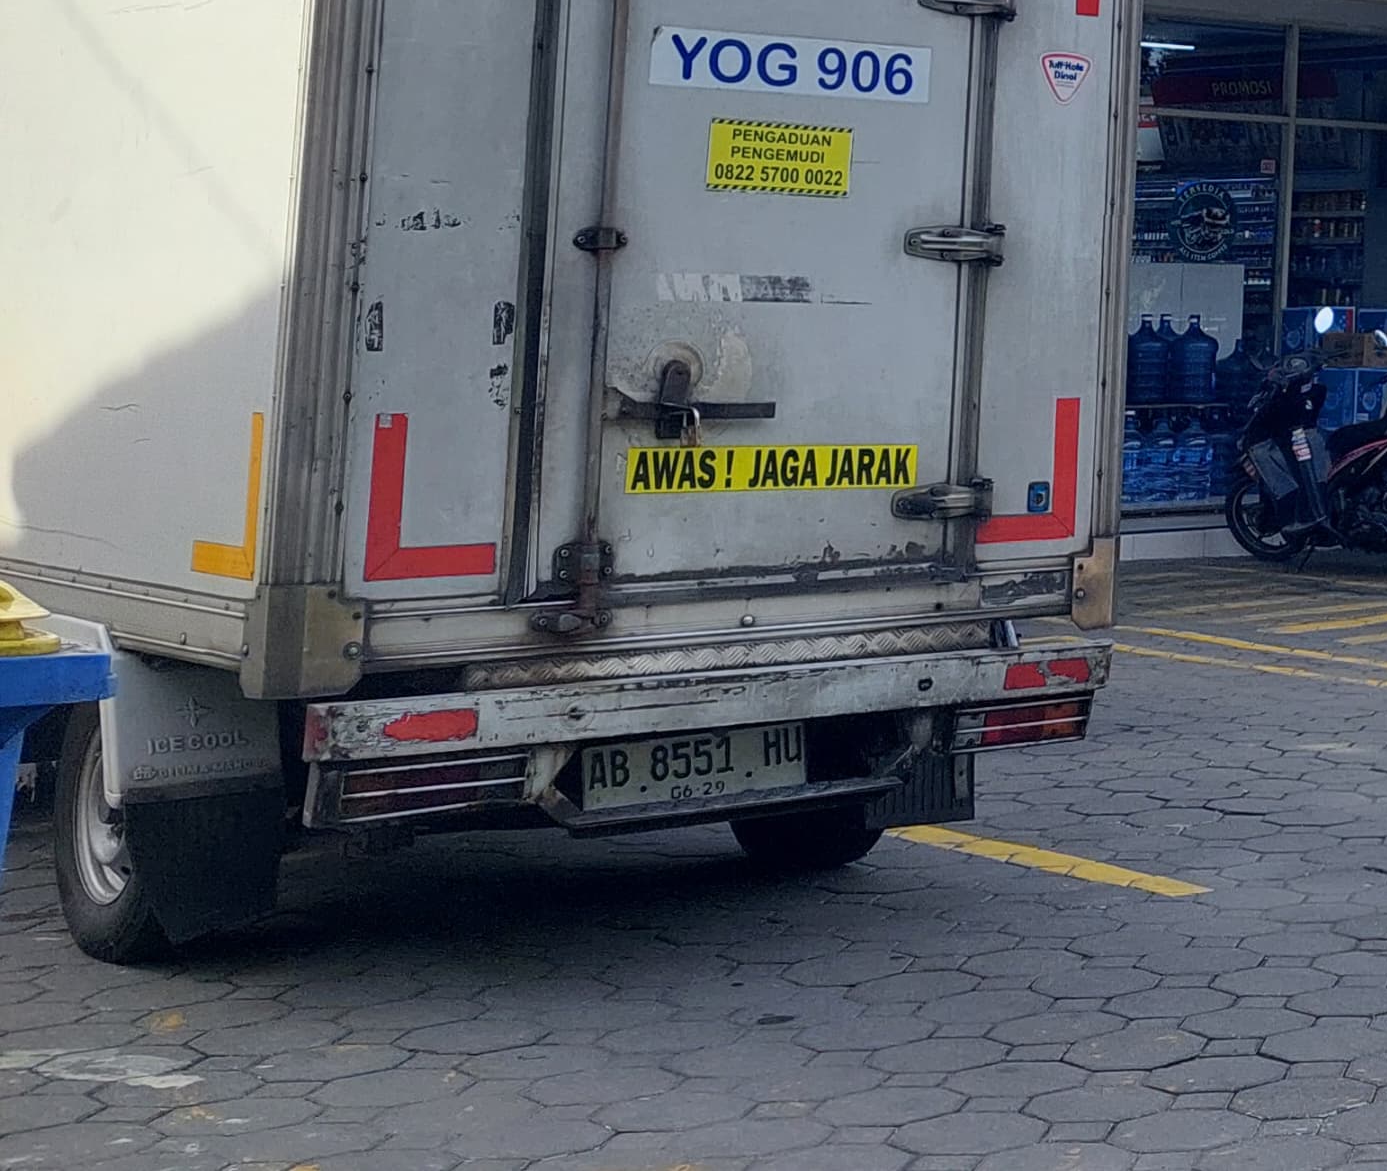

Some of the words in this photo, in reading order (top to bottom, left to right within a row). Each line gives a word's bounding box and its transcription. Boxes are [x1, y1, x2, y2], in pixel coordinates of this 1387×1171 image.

[672, 34, 797, 87] YOG
[817, 47, 913, 96] 906
[1212, 80, 1273, 97] PROMOSI
[732, 128, 832, 147] PENGADUAN
[730, 146, 825, 164] PENGEMUDI
[714, 163, 754, 181] 0822
[760, 166, 799, 184] 5700
[804, 168, 843, 187] 0022
[748, 449, 818, 488] JAGA
[825, 448, 911, 486] JARAK
[148, 736, 185, 755] ICE
[188, 730, 248, 751] COOL
[589, 749, 630, 791] AB
[651, 735, 734, 782] 8551
[763, 725, 803, 767] HU
